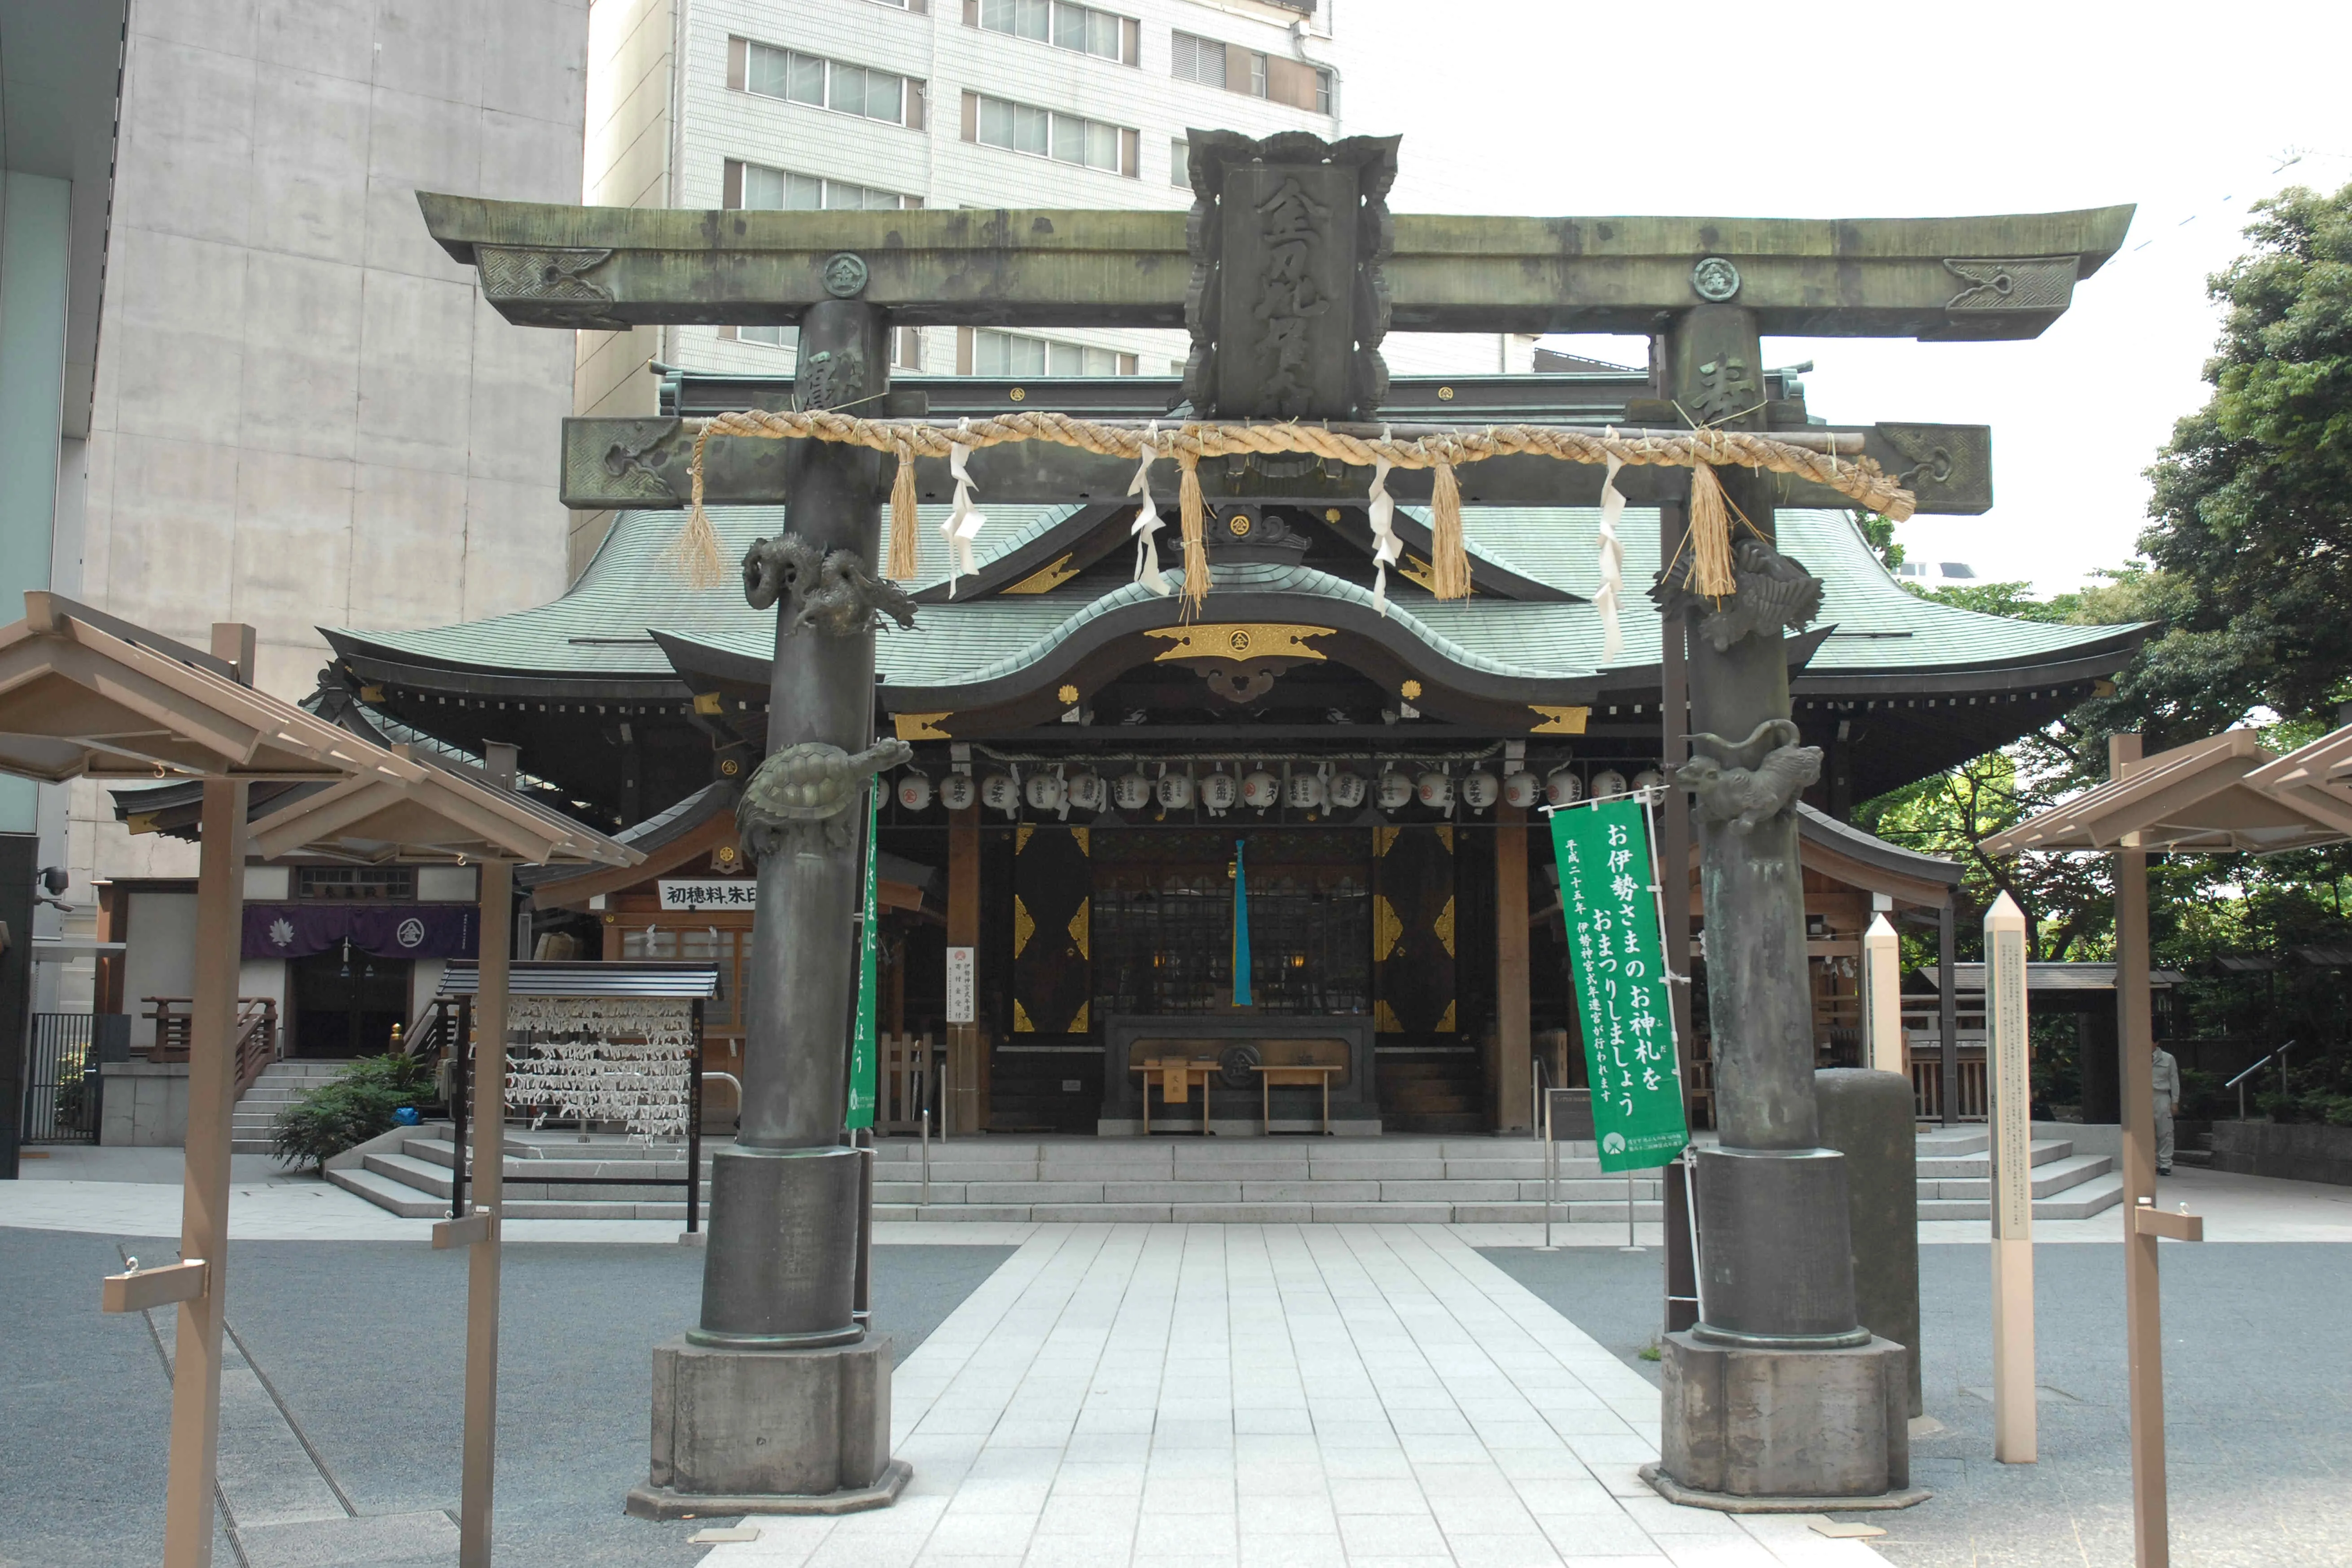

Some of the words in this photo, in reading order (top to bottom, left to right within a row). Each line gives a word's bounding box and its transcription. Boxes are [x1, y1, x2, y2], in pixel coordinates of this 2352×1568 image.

[1565, 839, 1587, 915] 平成二十五年
[1607, 824, 1662, 1091] お伊勢さまのお神札を
[1593, 909, 1634, 1116] おまつりしましょう
